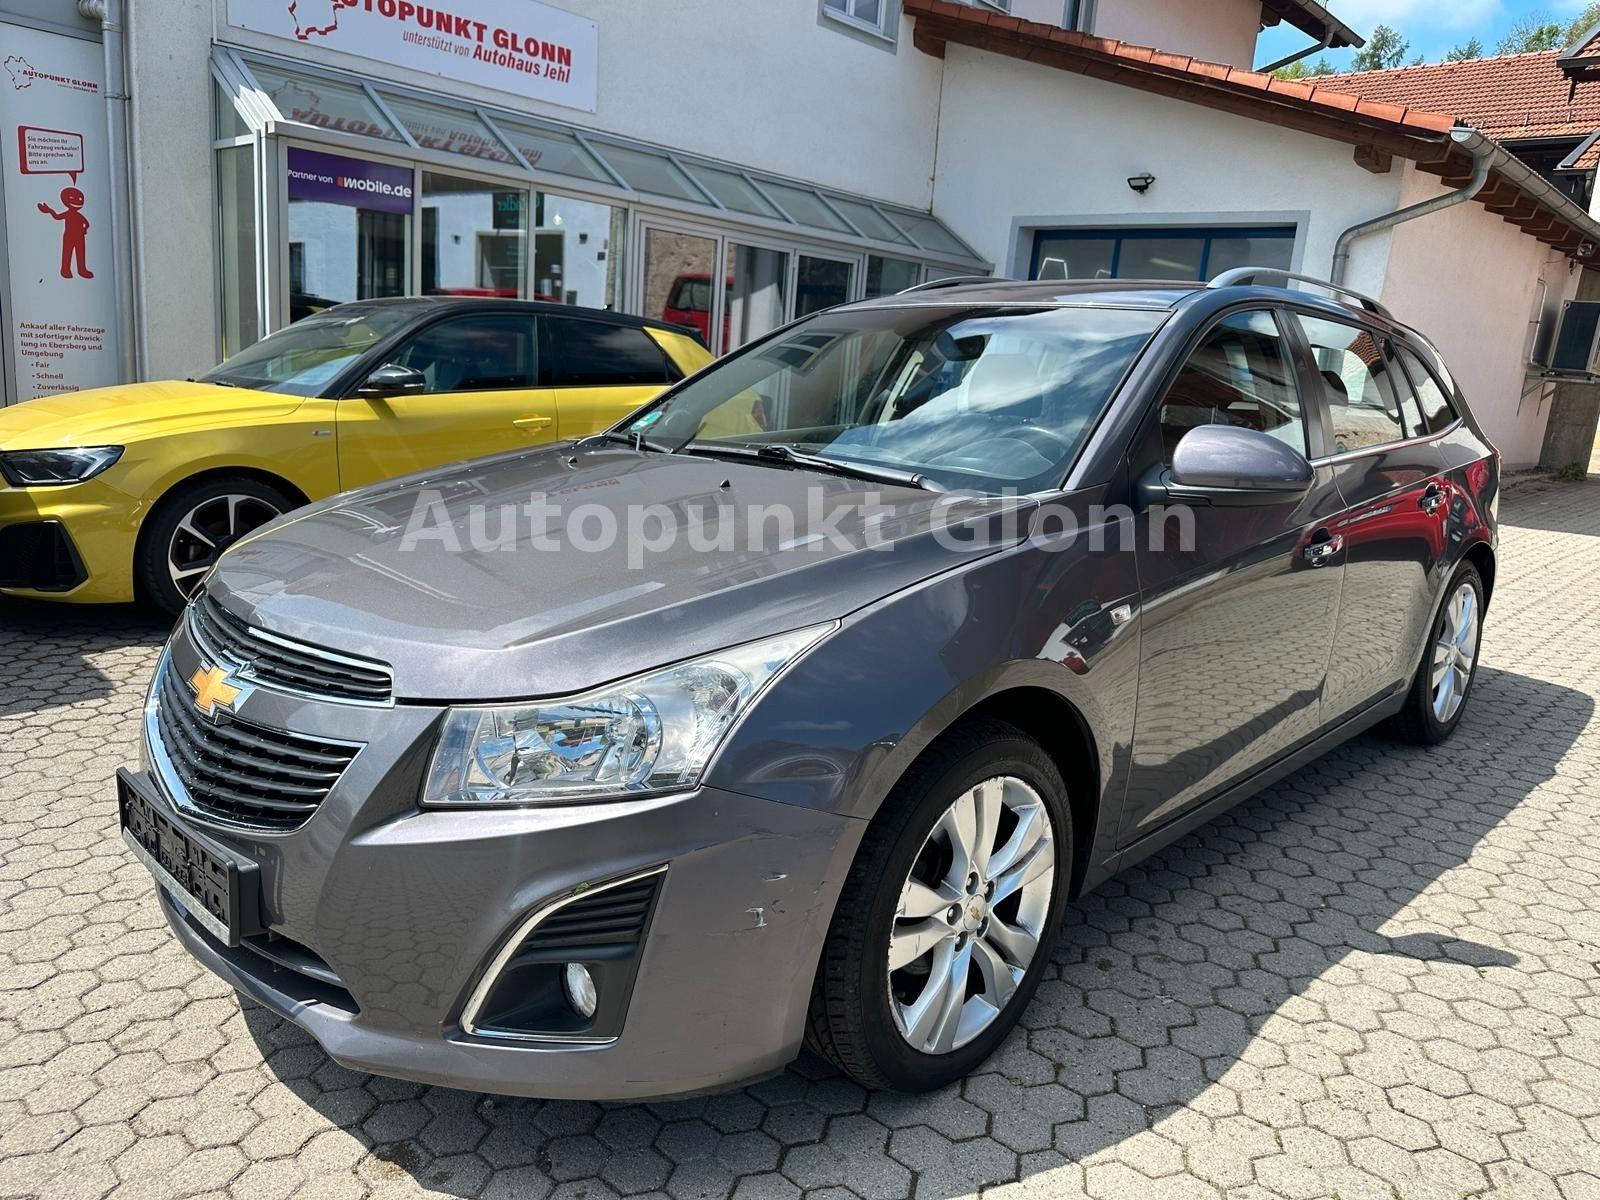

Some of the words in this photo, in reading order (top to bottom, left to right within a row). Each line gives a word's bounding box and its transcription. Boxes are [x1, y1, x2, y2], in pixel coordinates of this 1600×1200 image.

[331, 0, 487, 42] TOPUNKT
[493, 28, 572, 67] GLONN
[402, 30, 452, 53] unterstützt
[454, 44, 470, 57] von
[473, 44, 540, 76] Autohaus
[543, 63, 571, 84] Jehl
[22, 69, 70, 84] AUTOPUNKT
[72, 79, 98, 89] GLONN
[288, 169, 317, 182] Partner
[318, 175, 334, 184] von
[343, 177, 412, 198] mobile.de
[20, 322, 47, 330] Ankauf
[67, 325, 106, 334] Fahrzeuge
[35, 332, 72, 341] sofortiger
[74, 334, 103, 342] Abwick-
[20, 340, 38, 348] lung
[49, 341, 87, 351] Ebersberg
[21, 349, 64, 359] Umgebung
[36, 372, 64, 380] Schnell
[36, 383, 80, 392] Zuverlässig
